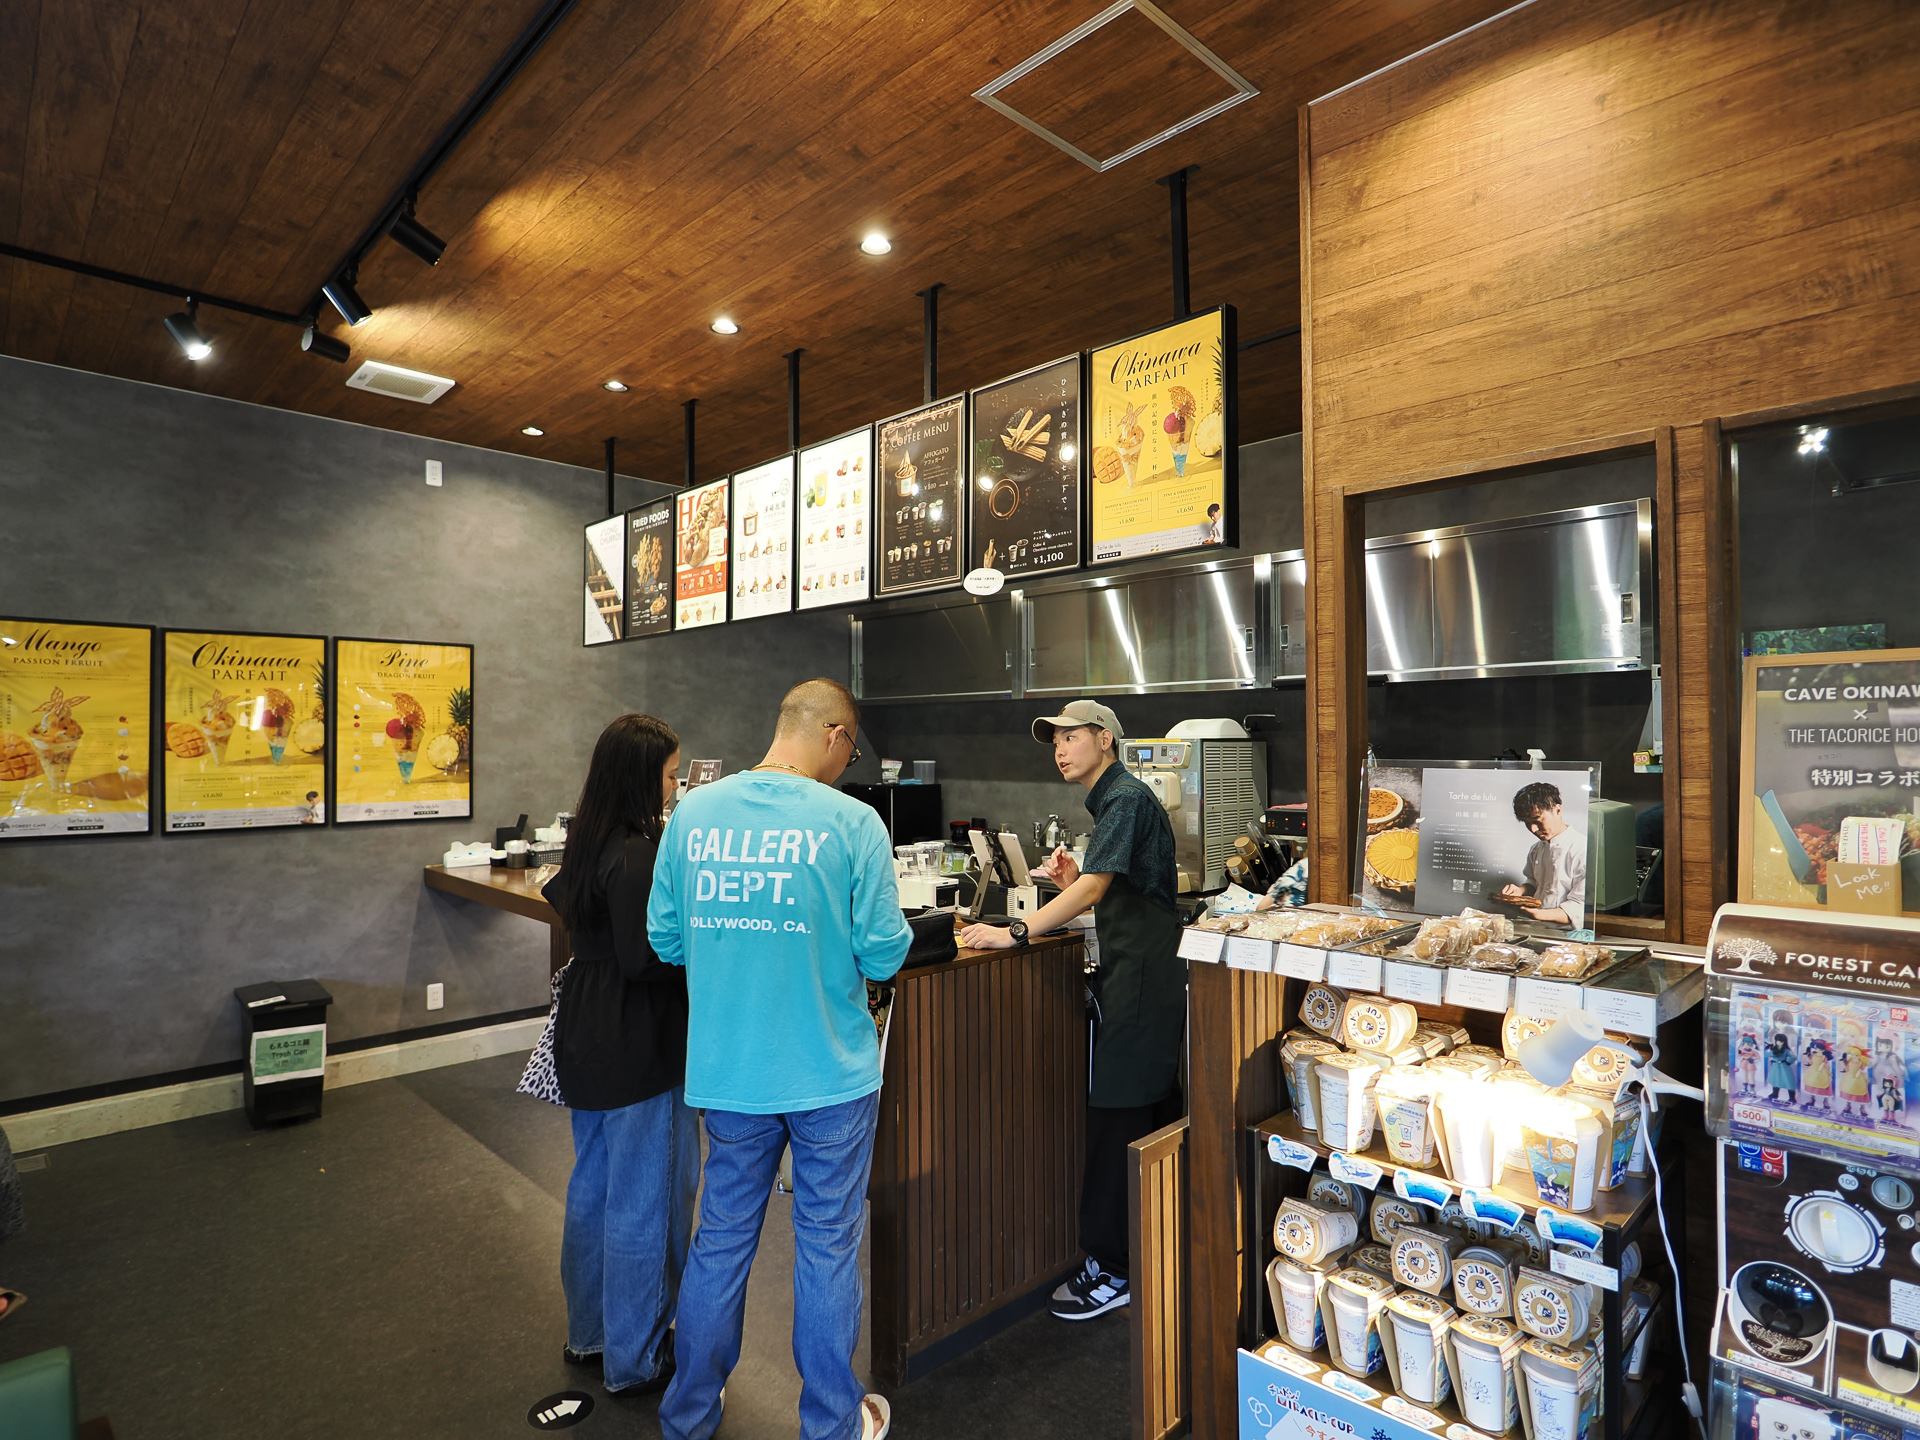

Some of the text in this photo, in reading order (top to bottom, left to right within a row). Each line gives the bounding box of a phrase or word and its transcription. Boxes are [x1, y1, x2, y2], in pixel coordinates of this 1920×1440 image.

[1110, 341, 1201, 384] Okinawa
[1125, 362, 1189, 392] PARFAIT
[891, 422, 949, 448] COFFEE MENU
[633, 509, 670, 528] FRIED FOODS
[1033, 552, 1064, 564] ¥1,100
[5, 629, 102, 659] Mango
[13, 657, 60, 665] PASSION
[192, 641, 301, 668] Okinawa
[380, 648, 429, 667] Pine
[212, 669, 287, 681] PARFAIT
[1784, 687, 1837, 701] CAVE
[1789, 728, 1920, 743] THE TACORICE HO
[1811, 768, 1920, 787] 特別コラボ
[1448, 791, 1497, 801] Tarte de lulu
[687, 828, 829, 865] GALLERY
[1834, 867, 1880, 888] Look
[696, 870, 795, 905] DEPT.
[783, 920, 811, 934] CA.
[1785, 952, 1920, 979] FOREST CA
[1812, 971, 1911, 989] By CAVE OKINAWA
[1866, 1006, 1881, 1022] 2
[272, 1051, 291, 1059] Trash
[1840, 1178, 1857, 1187] 100
[1305, 1424, 1337, 1440] 今す
